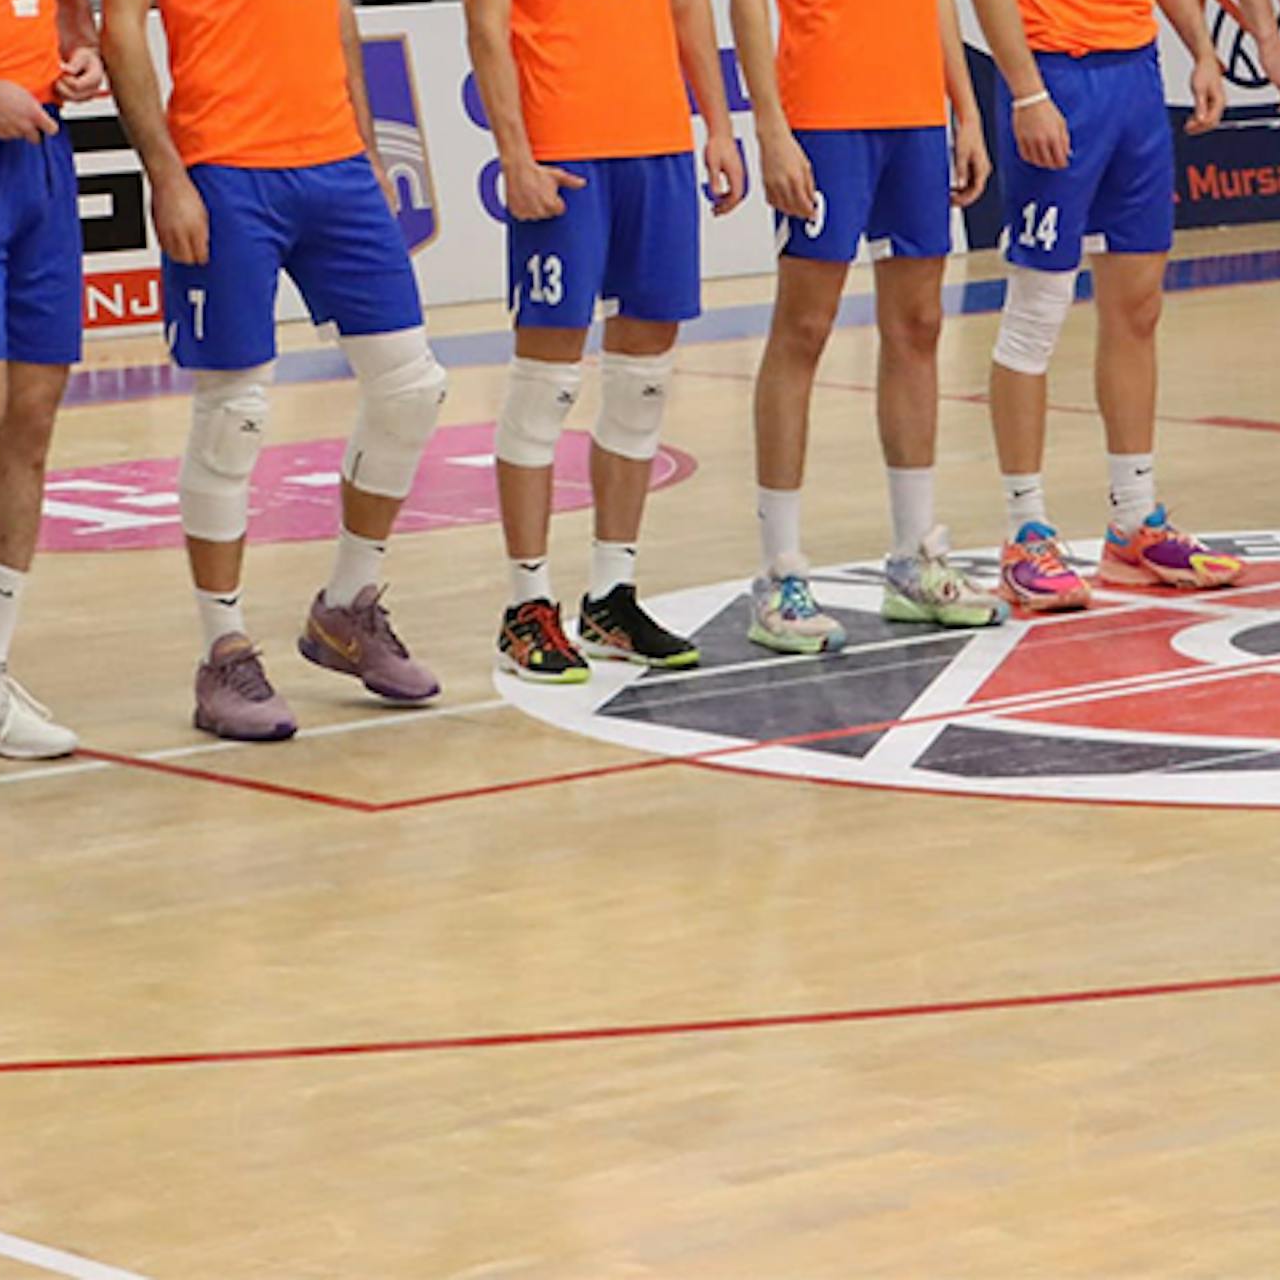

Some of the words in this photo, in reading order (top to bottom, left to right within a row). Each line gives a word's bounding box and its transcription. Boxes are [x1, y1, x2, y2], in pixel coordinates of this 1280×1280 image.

[1017, 201, 1060, 253] 14
[526, 252, 565, 307] 13
[186, 288, 207, 340] 7
